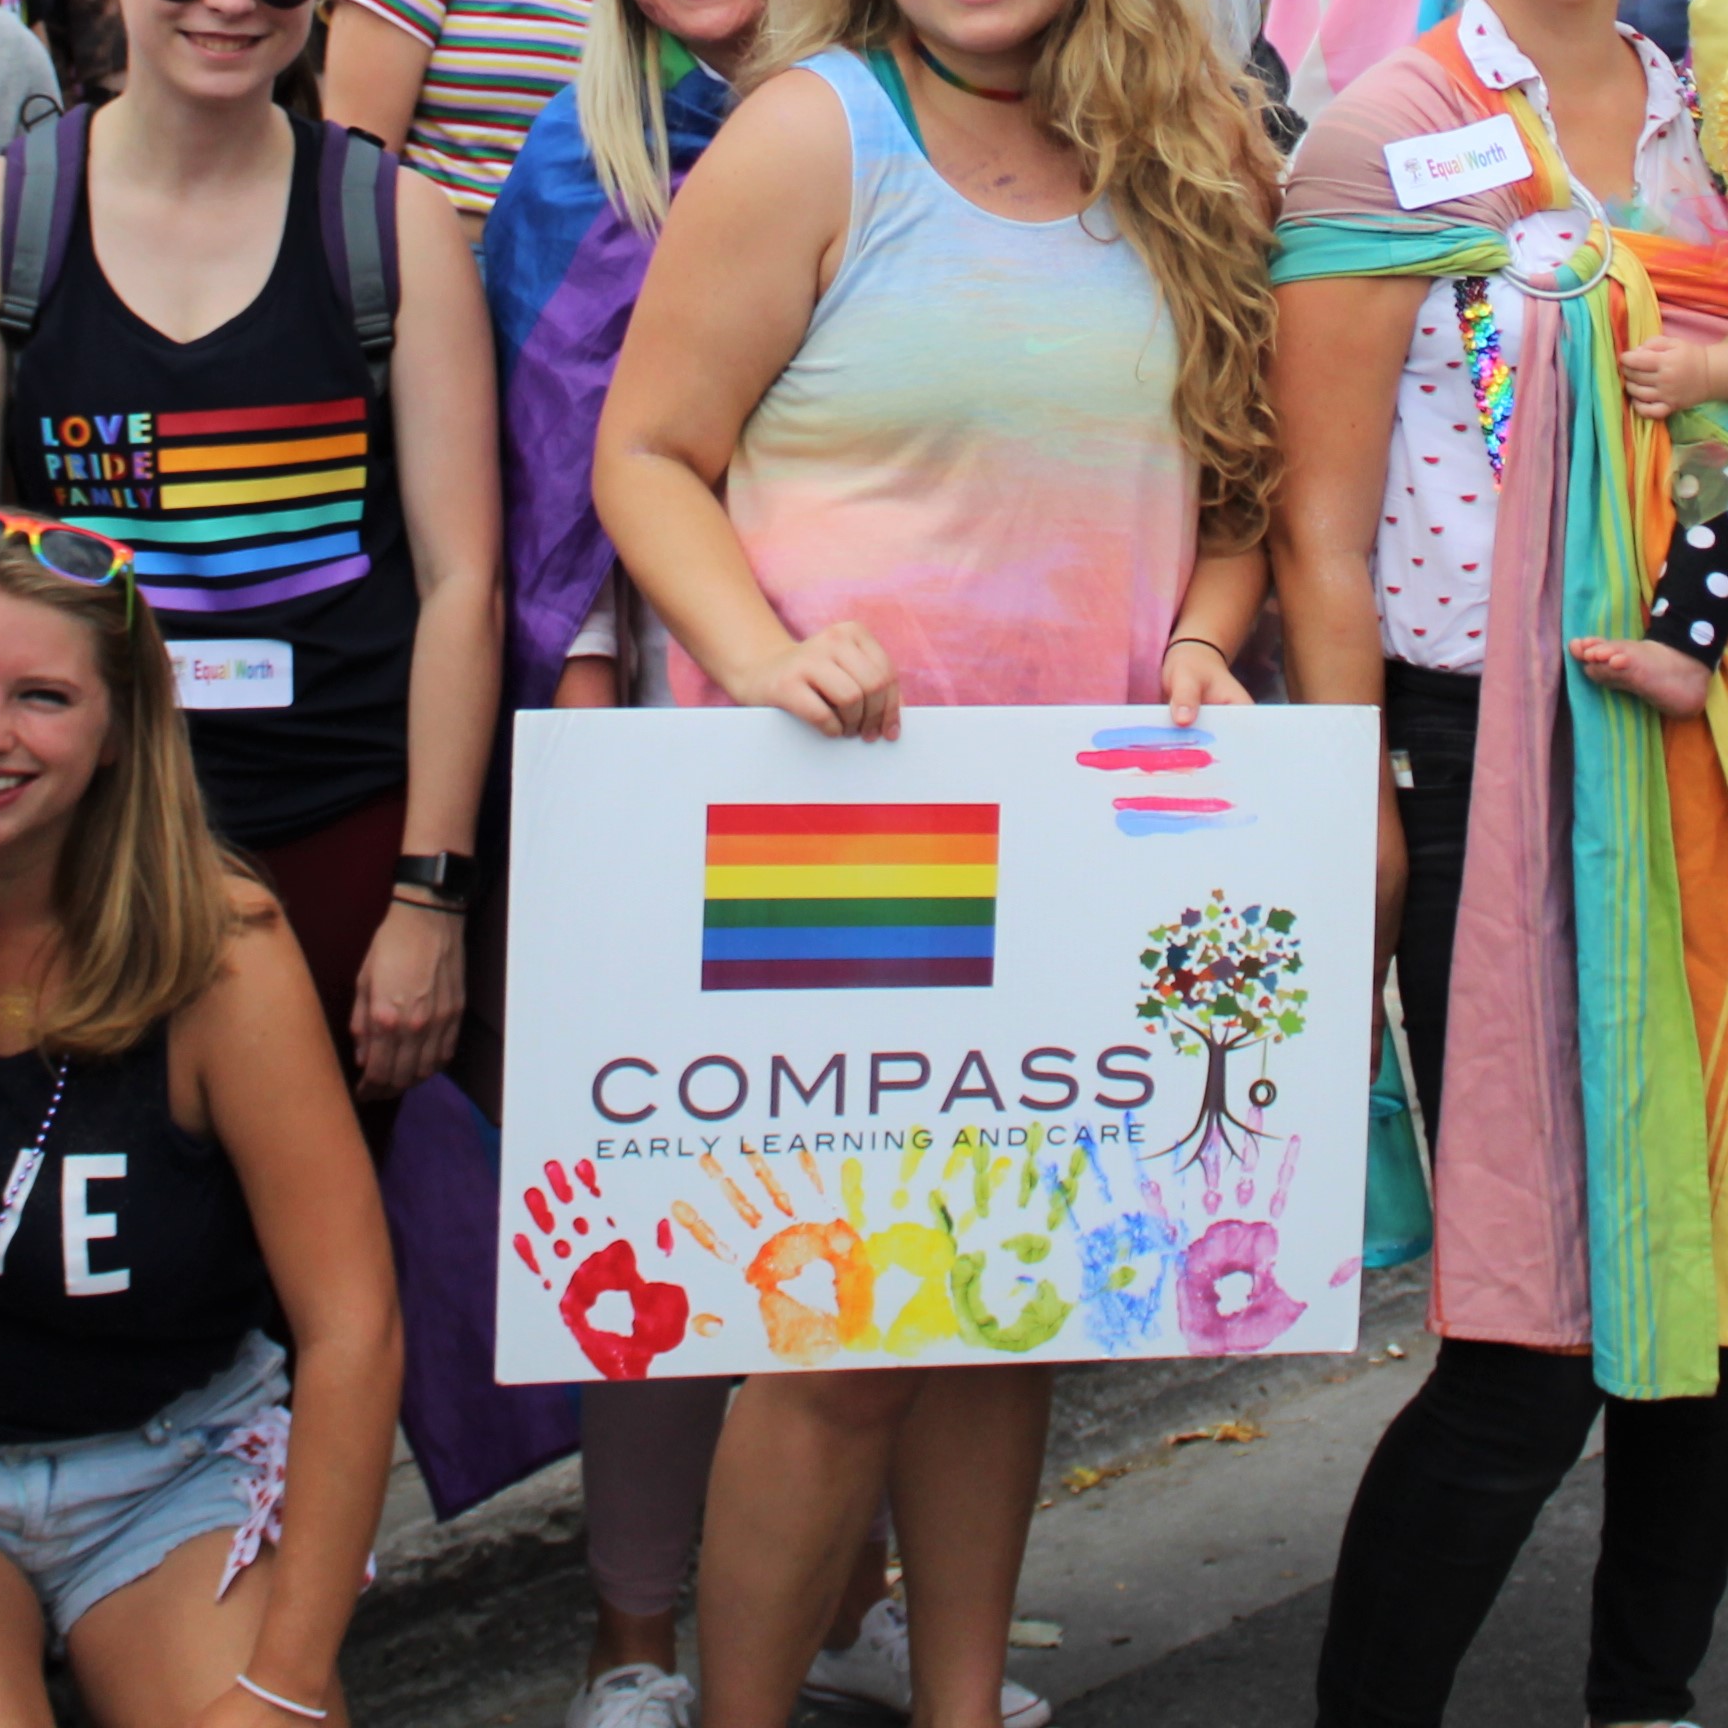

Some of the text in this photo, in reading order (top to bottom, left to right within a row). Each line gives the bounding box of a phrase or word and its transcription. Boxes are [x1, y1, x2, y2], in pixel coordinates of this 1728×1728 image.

[1426, 142, 1507, 181] Equal Worth
[40, 413, 152, 447] LOVE
[45, 451, 153, 480] PRIDE
[54, 486, 153, 509] FAMILY
[591, 1045, 1156, 1125] COMPASS
[597, 1123, 1147, 1160] EARLY LEARNING AND CARE
